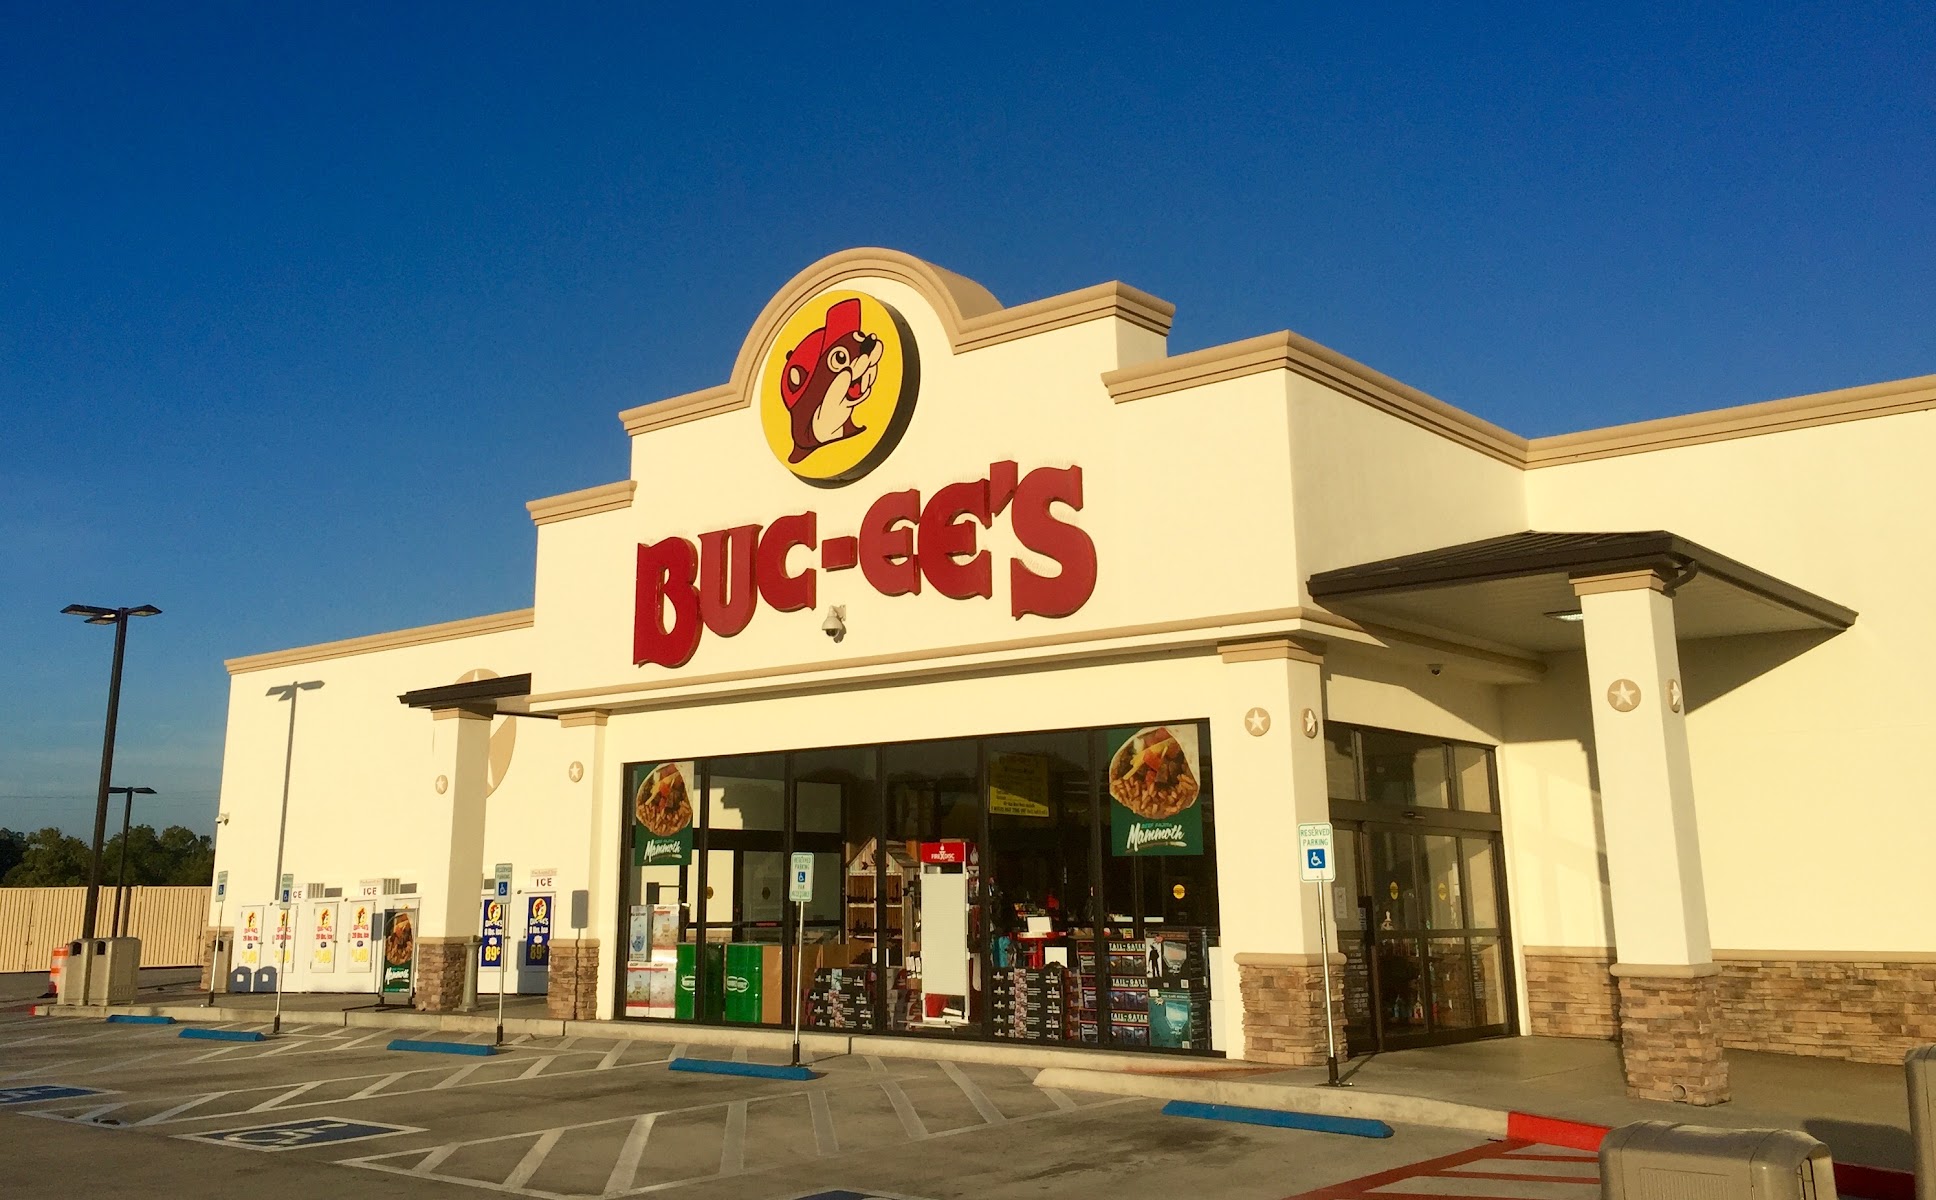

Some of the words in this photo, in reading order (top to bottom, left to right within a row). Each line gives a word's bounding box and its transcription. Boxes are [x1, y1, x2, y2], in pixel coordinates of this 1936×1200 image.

[633, 460, 1097, 668] BUC-EE'S
[1126, 822, 1185, 852] Mammoth
[1300, 829, 1330, 837] RESERVED
[1302, 838, 1329, 846] PARKING
[644, 839, 682, 863] Mammoth
[536, 877, 552, 887] ICE
[292, 890, 302, 898] CE
[363, 887, 377, 896] ICE
